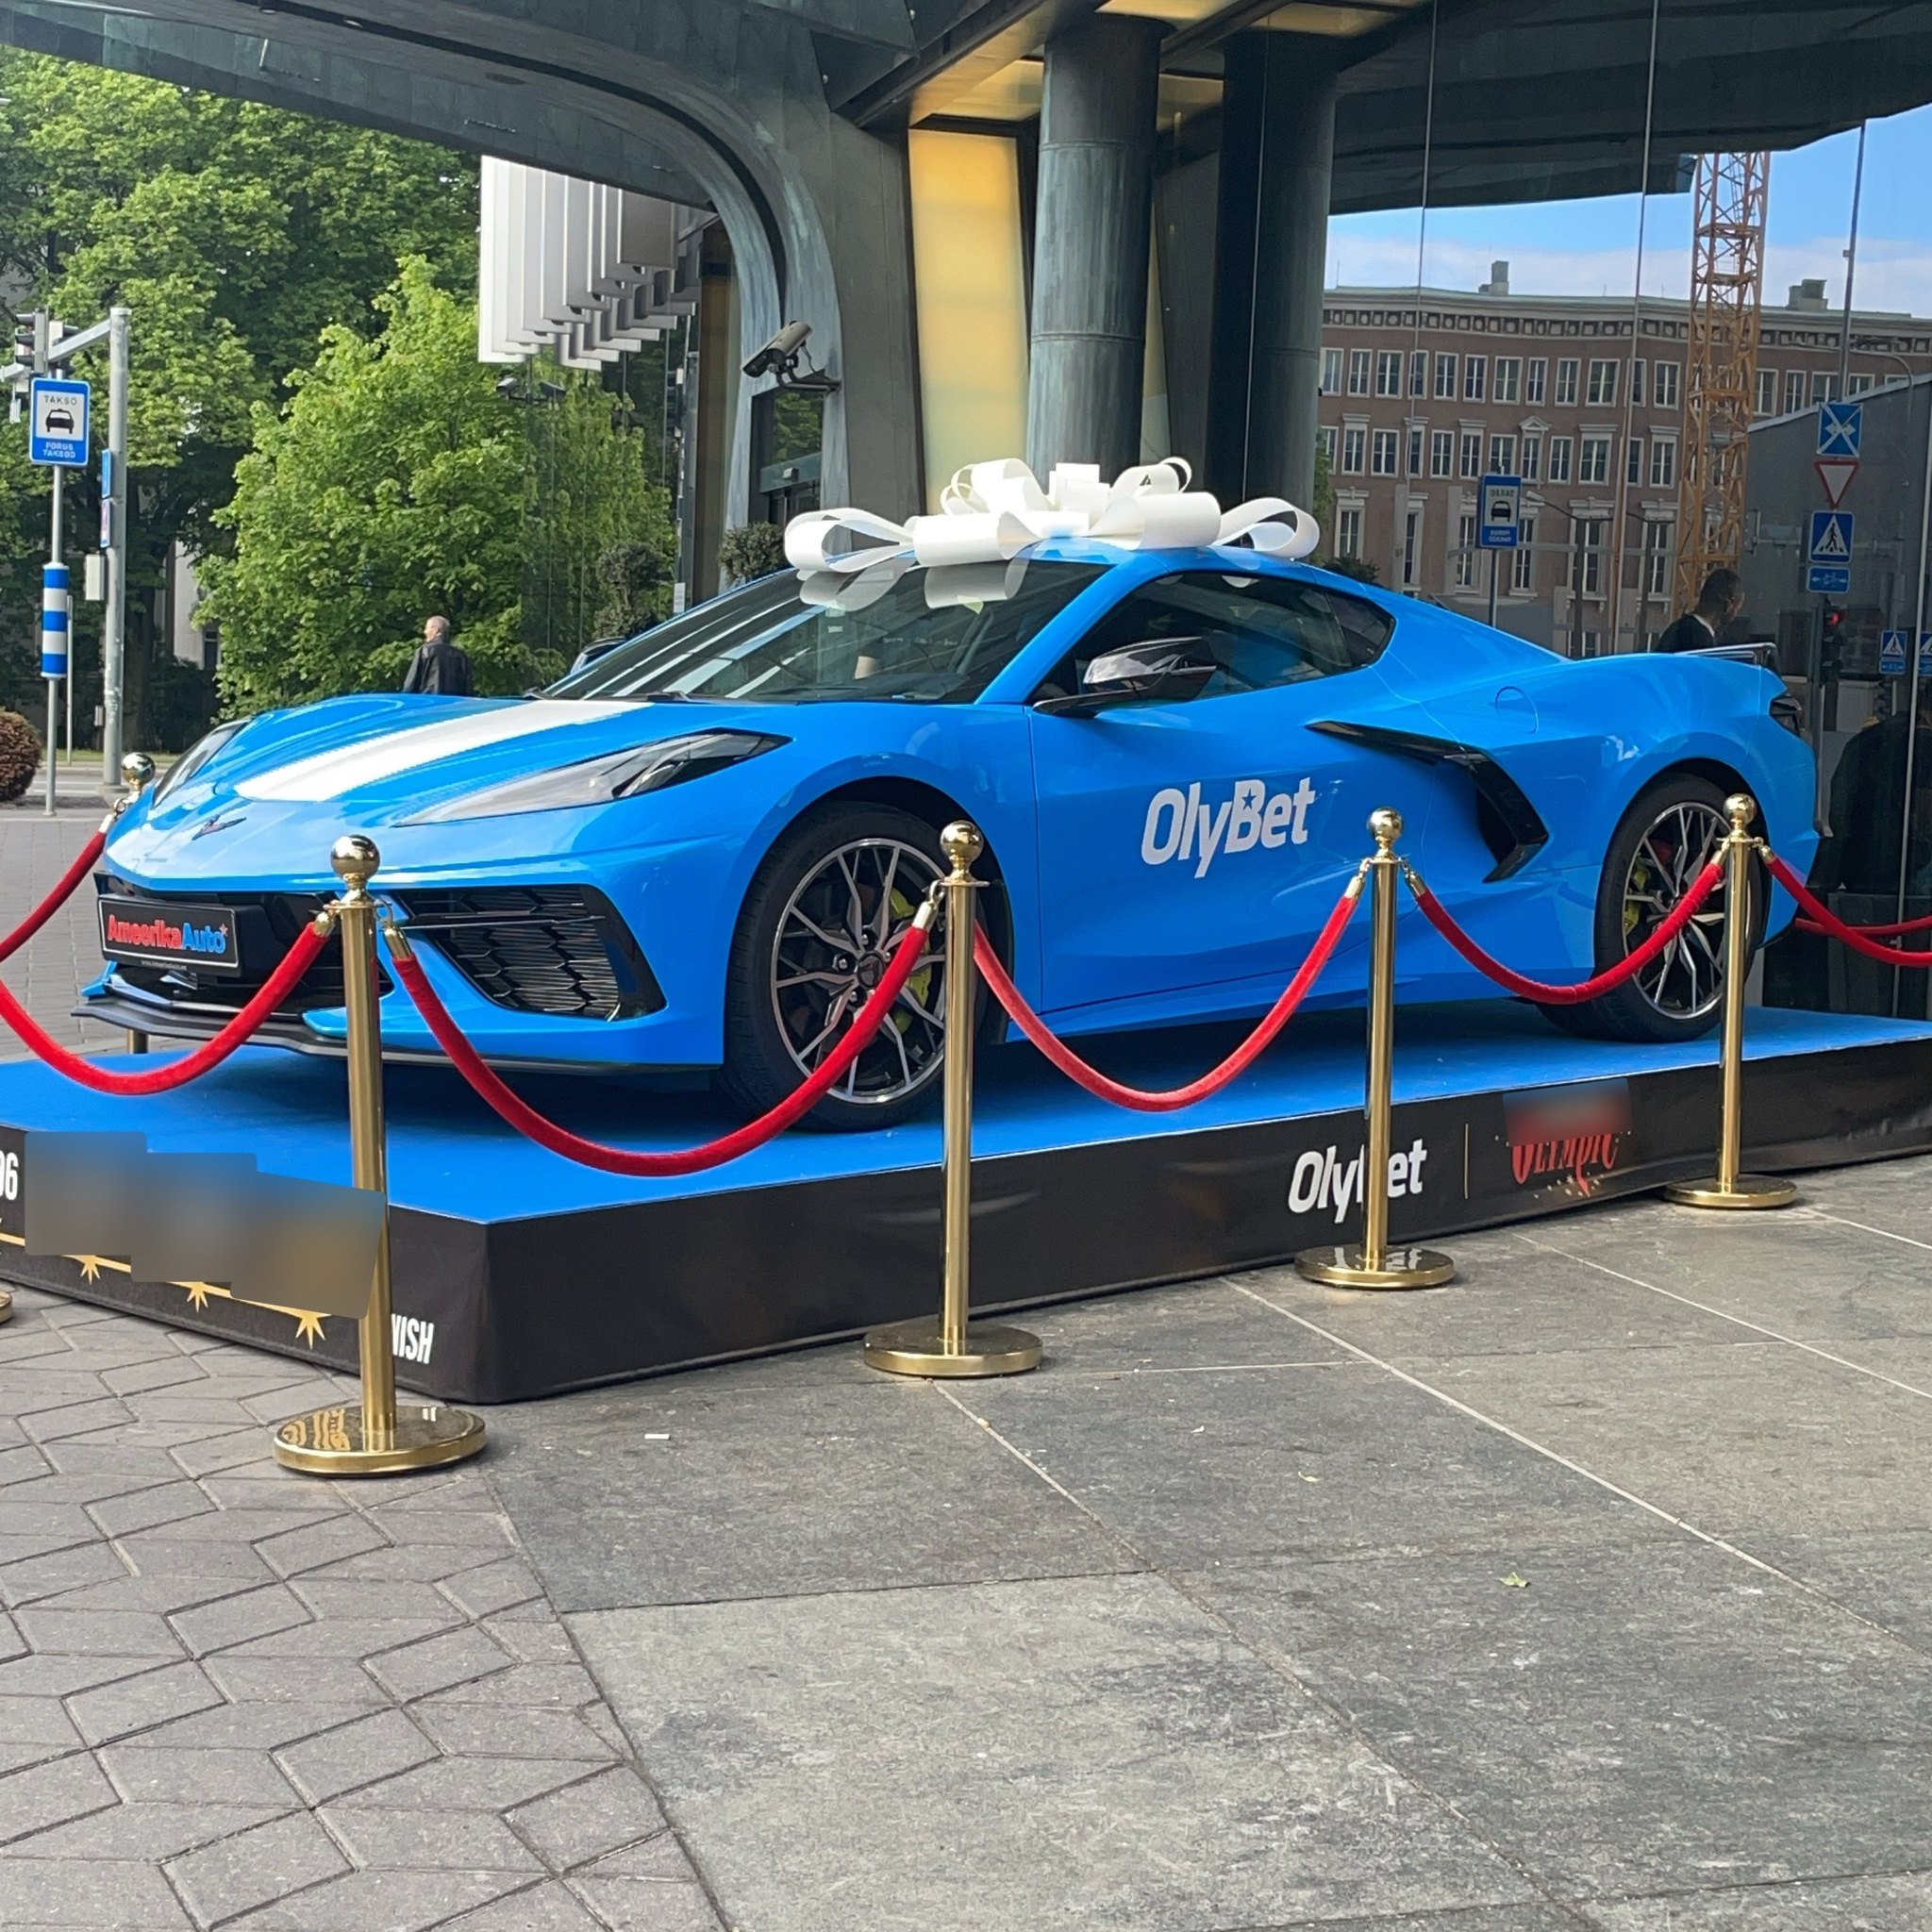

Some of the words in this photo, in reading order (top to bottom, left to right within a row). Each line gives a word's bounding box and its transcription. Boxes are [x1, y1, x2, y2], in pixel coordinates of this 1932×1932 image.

[44, 395, 77, 406] TAKSO
[1141, 776, 1316, 878] OlyBet
[107, 913, 226, 954] AmeerikaAuto
[1288, 1138, 1427, 1224] Olyet
